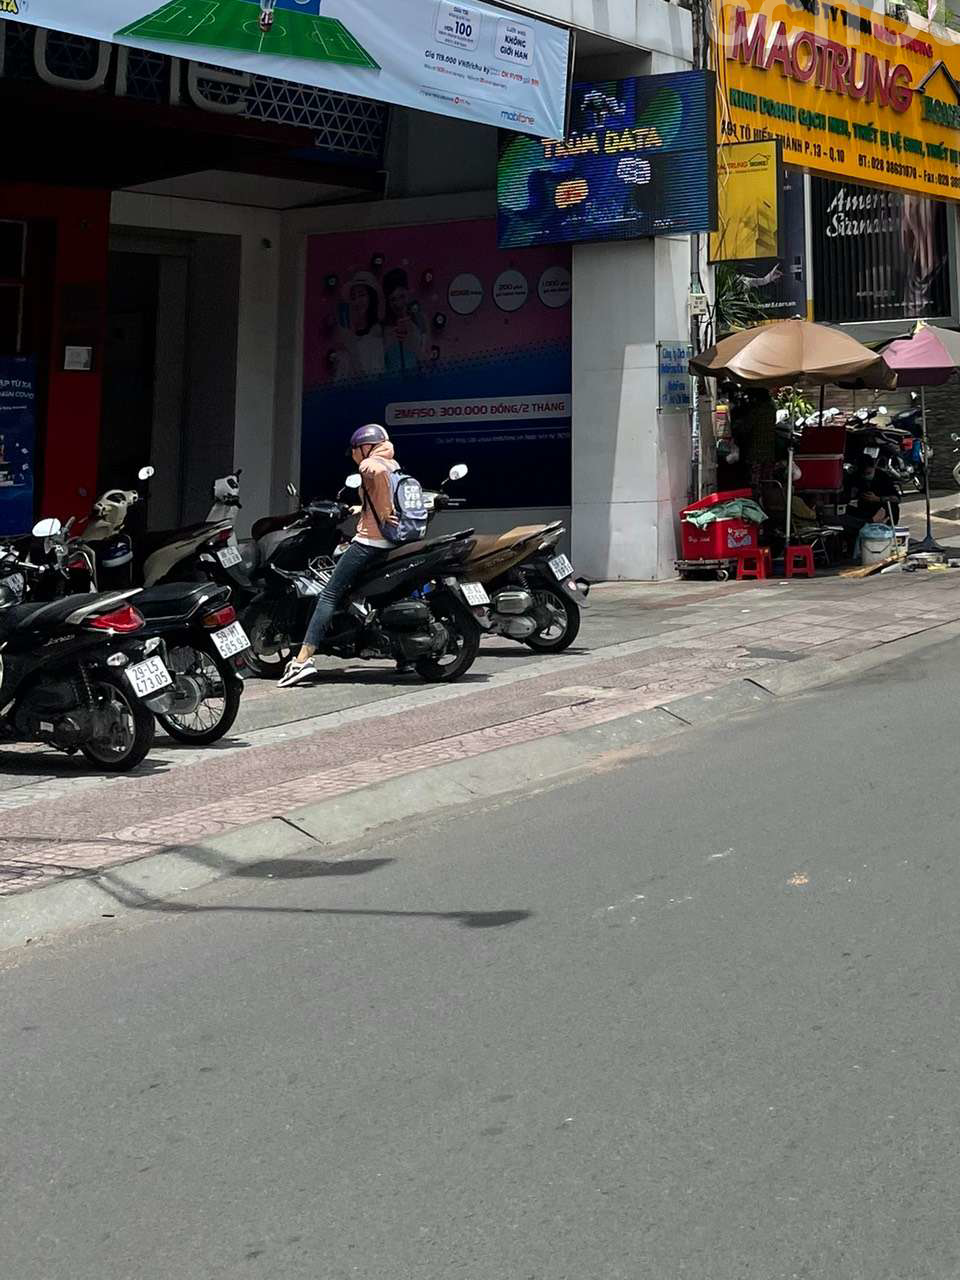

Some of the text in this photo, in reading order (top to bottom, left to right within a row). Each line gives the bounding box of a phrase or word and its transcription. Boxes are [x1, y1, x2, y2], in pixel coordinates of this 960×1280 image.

[455, 20, 473, 37] 100
[726, 5, 914, 115] MAOTRUNG
[501, 110, 535, 126] mobifone
